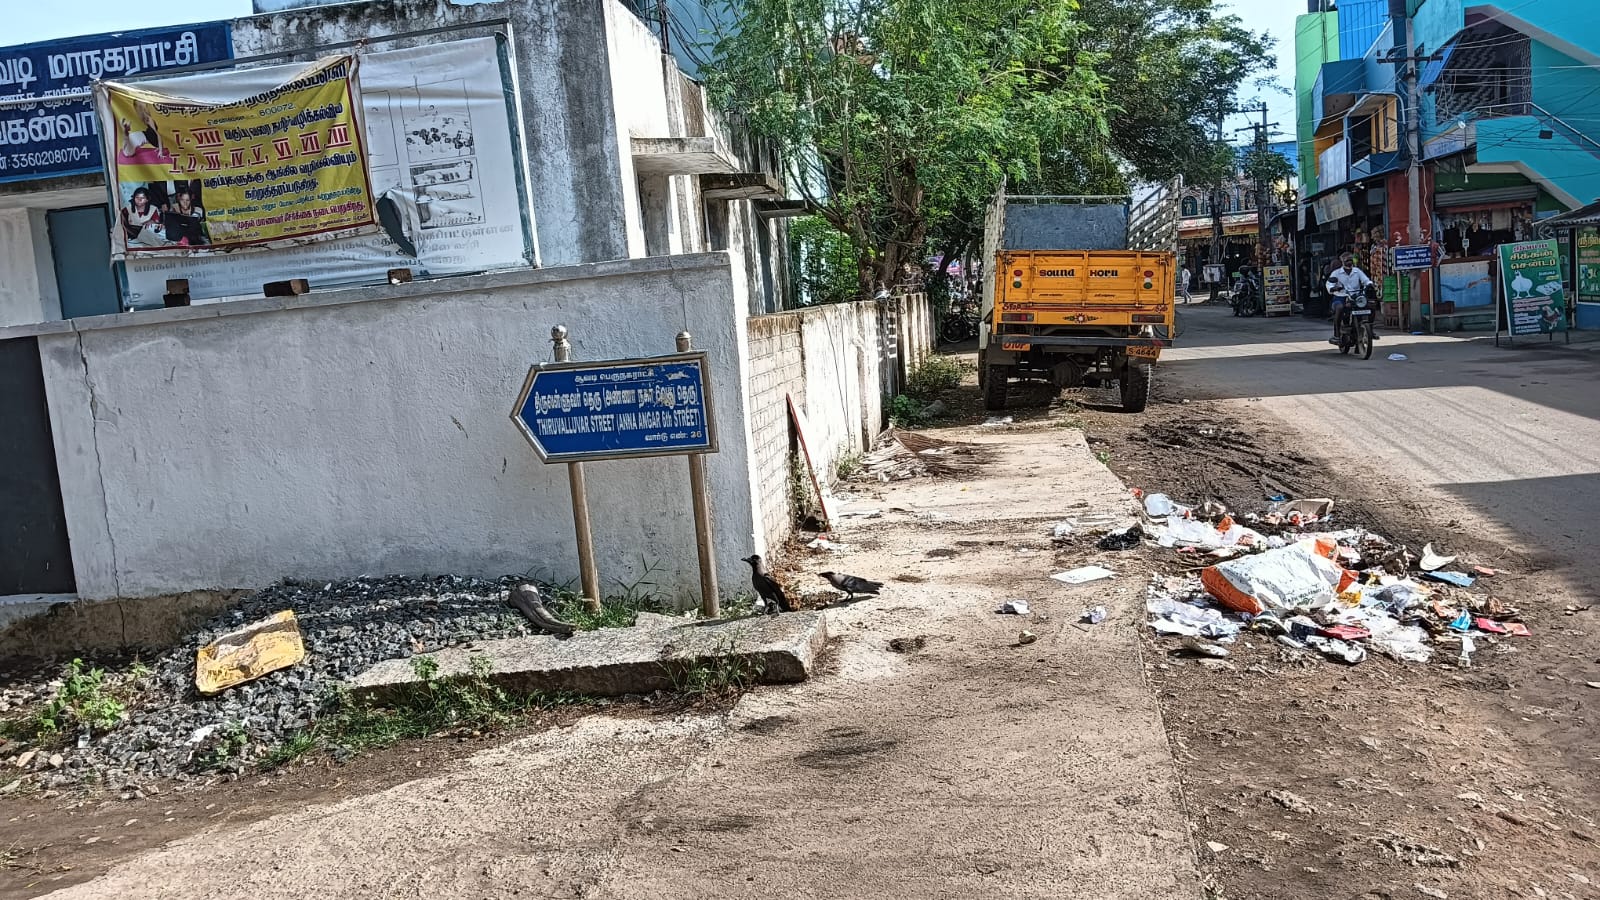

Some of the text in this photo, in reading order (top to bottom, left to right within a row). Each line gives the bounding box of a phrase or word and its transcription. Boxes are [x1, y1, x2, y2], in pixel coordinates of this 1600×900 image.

[48, 32, 199, 79] மாநகராட்சி
[1039, 268, 1075, 277] Sound
[535, 387, 581, 415] திருவள்ளுவர்
[583, 391, 602, 412] தெரு
[537, 415, 590, 436] THIRUVALLUVAR
[590, 414, 614, 433] STREET
[616, 412, 638, 435] (ANNA
[638, 411, 661, 430] ANGAR
[661, 410, 673, 428] 6th
